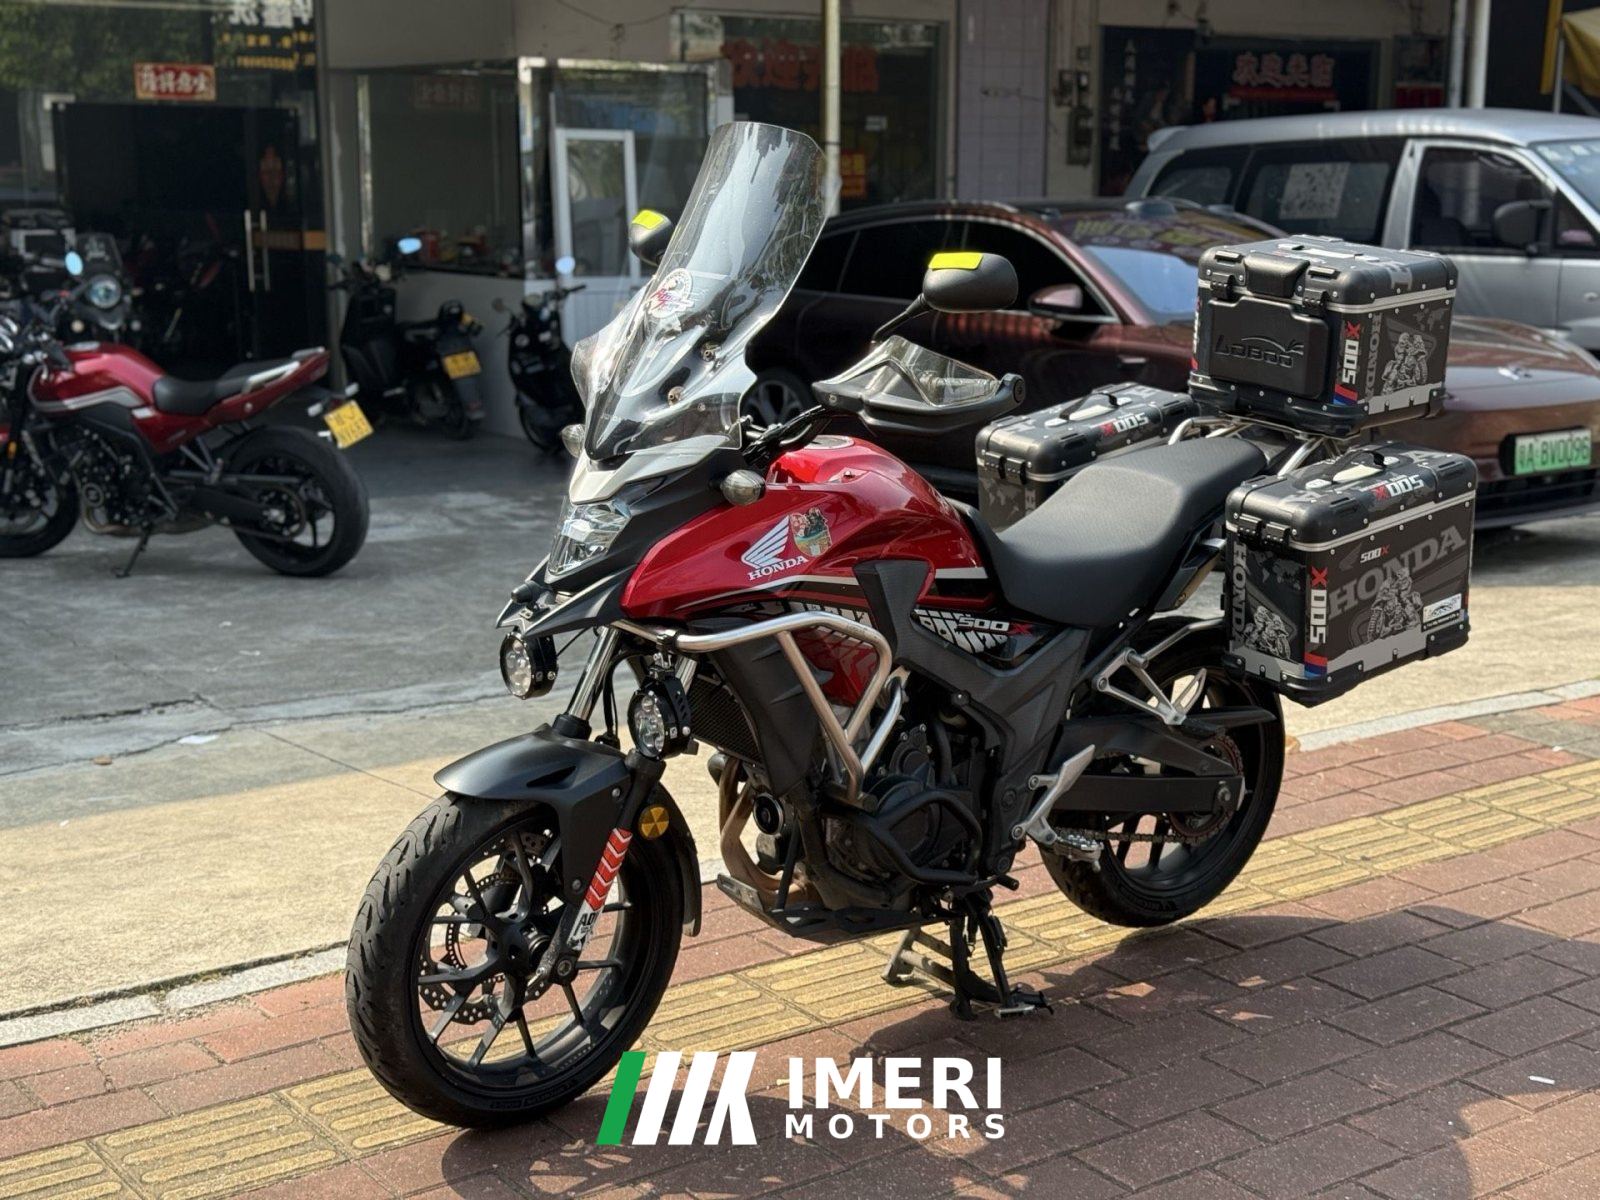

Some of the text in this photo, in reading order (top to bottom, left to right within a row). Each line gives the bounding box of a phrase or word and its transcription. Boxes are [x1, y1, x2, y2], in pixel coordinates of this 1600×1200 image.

[1342, 321, 1361, 385] 500X
[747, 555, 809, 581] HONDA
[1326, 525, 1466, 621] HONDA
[1360, 544, 1391, 564] 500X
[1309, 566, 1329, 644] 500X
